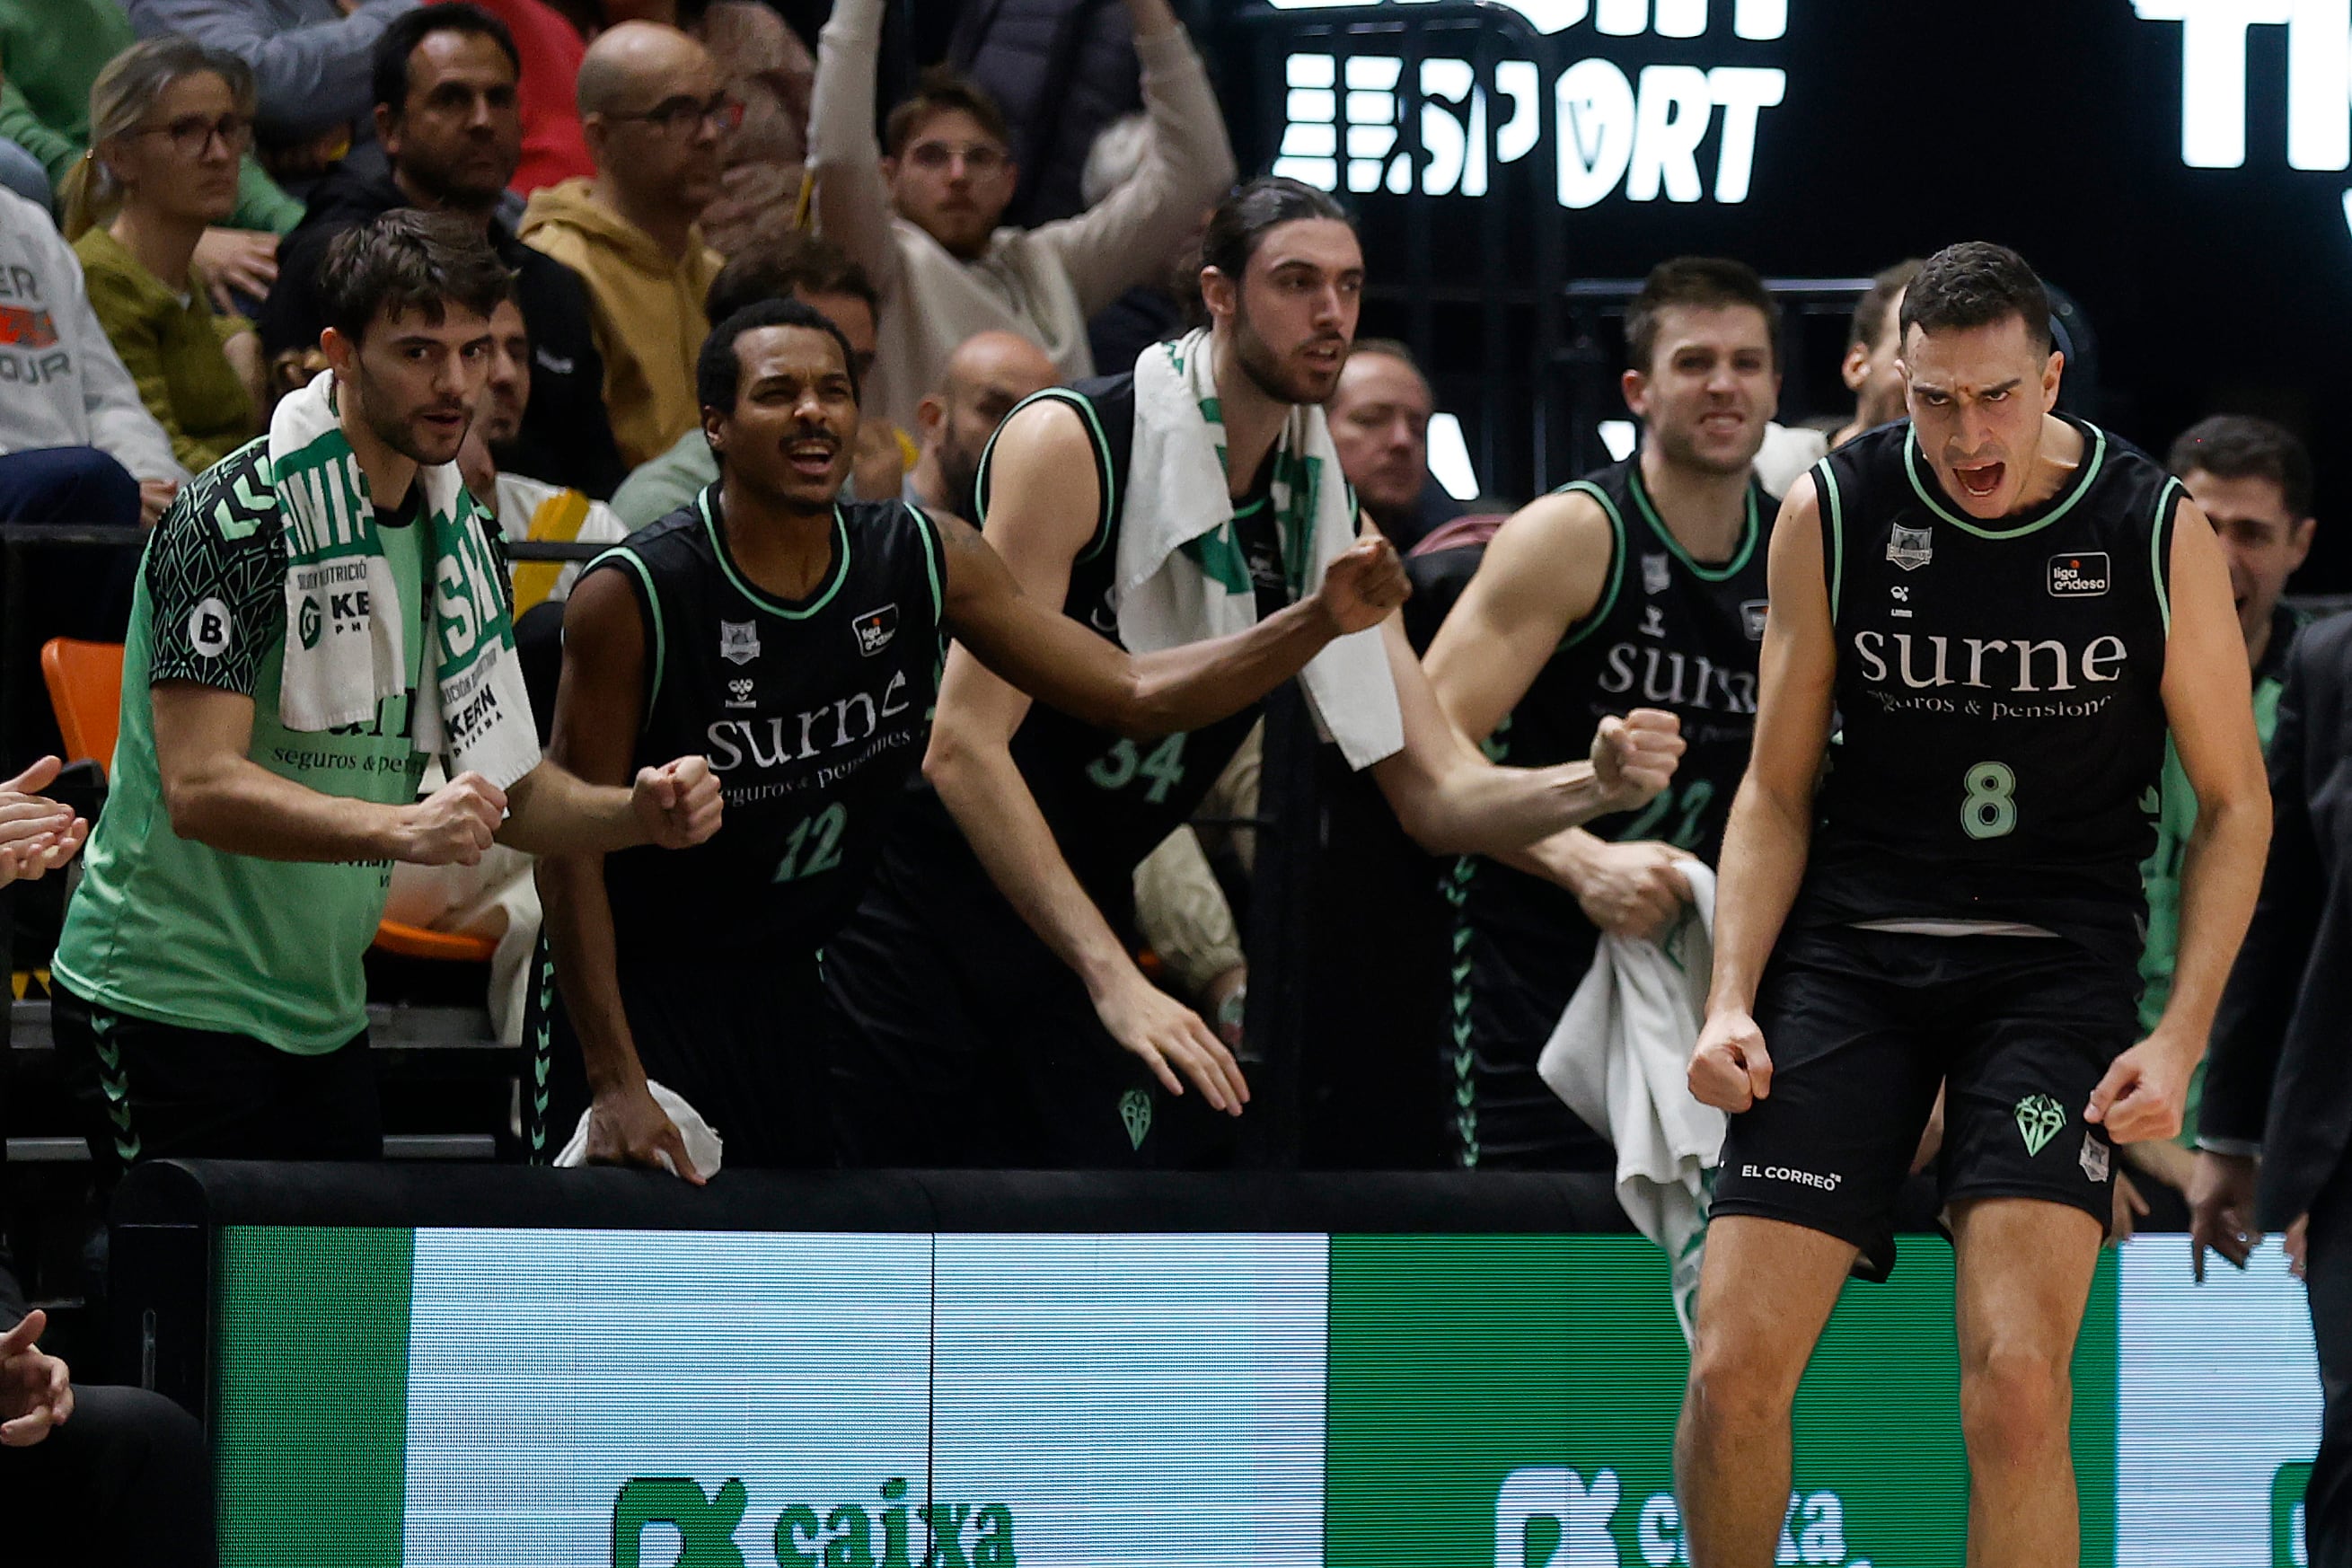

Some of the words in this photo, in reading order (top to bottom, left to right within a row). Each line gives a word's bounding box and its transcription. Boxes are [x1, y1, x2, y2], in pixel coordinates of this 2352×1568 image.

[2053, 566, 2078, 580] liga
[2053, 577, 2106, 591] endesa
[198, 612, 223, 644] B
[1854, 630, 2127, 692] surne
[706, 669, 910, 771] surne
[273, 745, 357, 771] seguros
[1960, 761, 2018, 840] 8
[772, 801, 848, 884] 12
[1741, 1165, 1762, 1177] EL
[1765, 1167, 1836, 1192] CORREO
